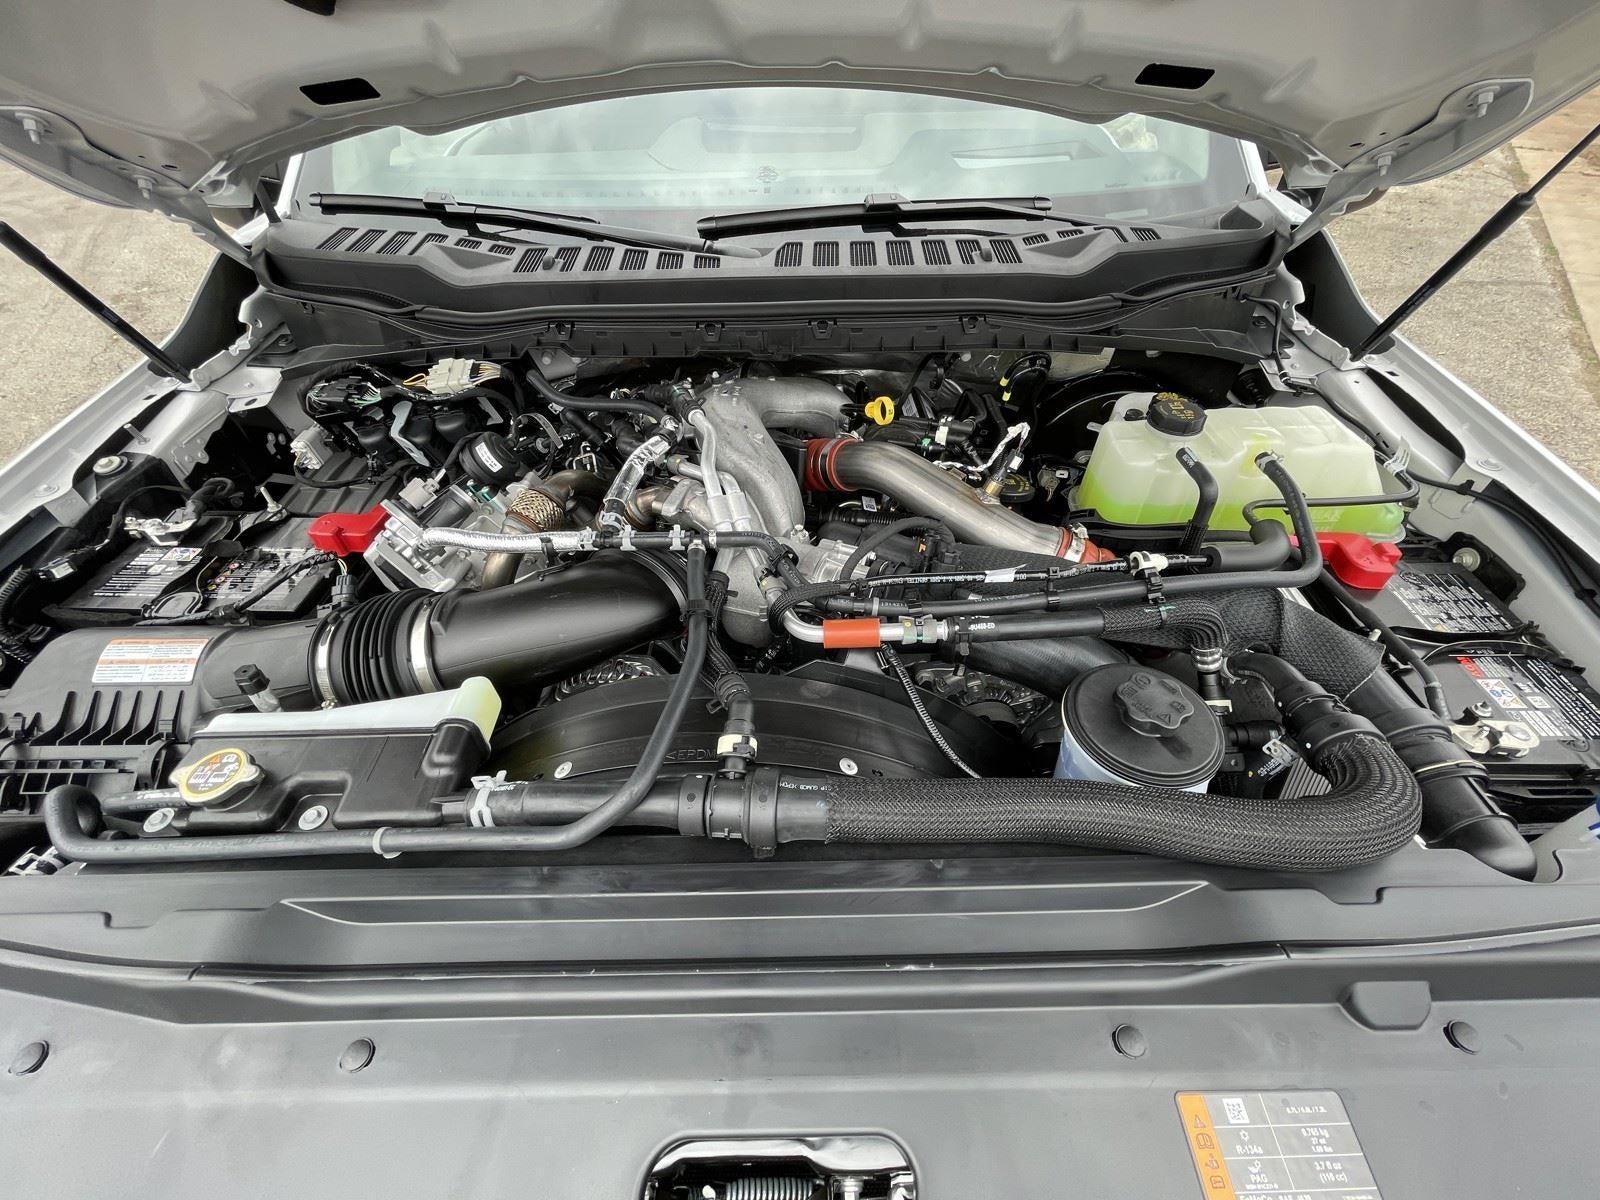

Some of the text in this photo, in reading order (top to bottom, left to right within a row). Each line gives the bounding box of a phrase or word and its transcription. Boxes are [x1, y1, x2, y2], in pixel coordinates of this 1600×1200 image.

[1319, 1128, 1329, 1138] kg
[1236, 1144, 1263, 1154] R-134a
[1250, 1174, 1268, 1184] PAG
